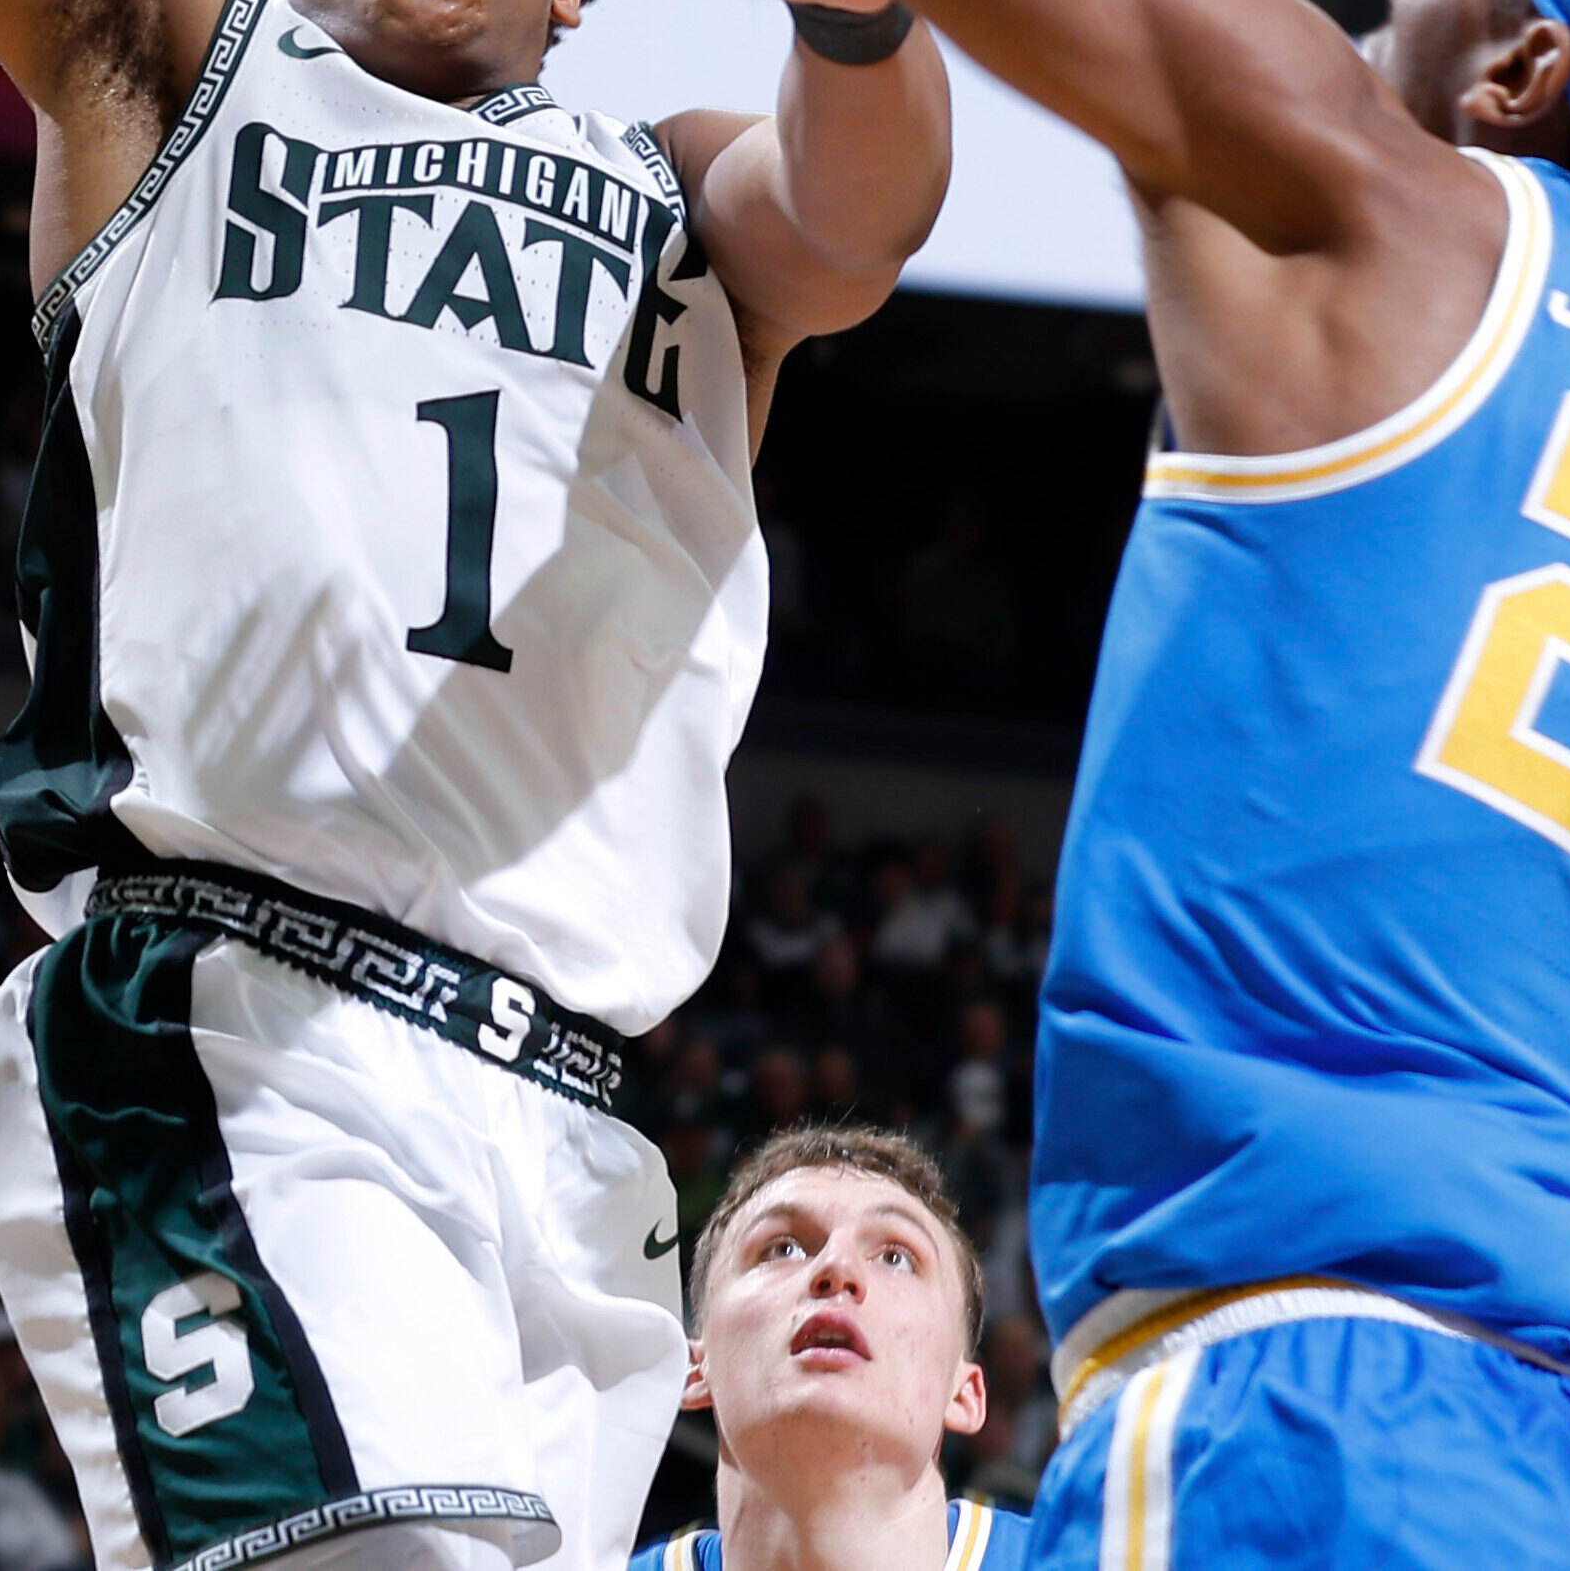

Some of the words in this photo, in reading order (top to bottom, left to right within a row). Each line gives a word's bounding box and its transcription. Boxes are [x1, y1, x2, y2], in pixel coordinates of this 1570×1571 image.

[212, 121, 708, 424] STATE
[332, 141, 631, 244] MICHIGAN
[406, 389, 514, 673] 1
[476, 978, 537, 1062] S
[140, 1270, 255, 1437] S
